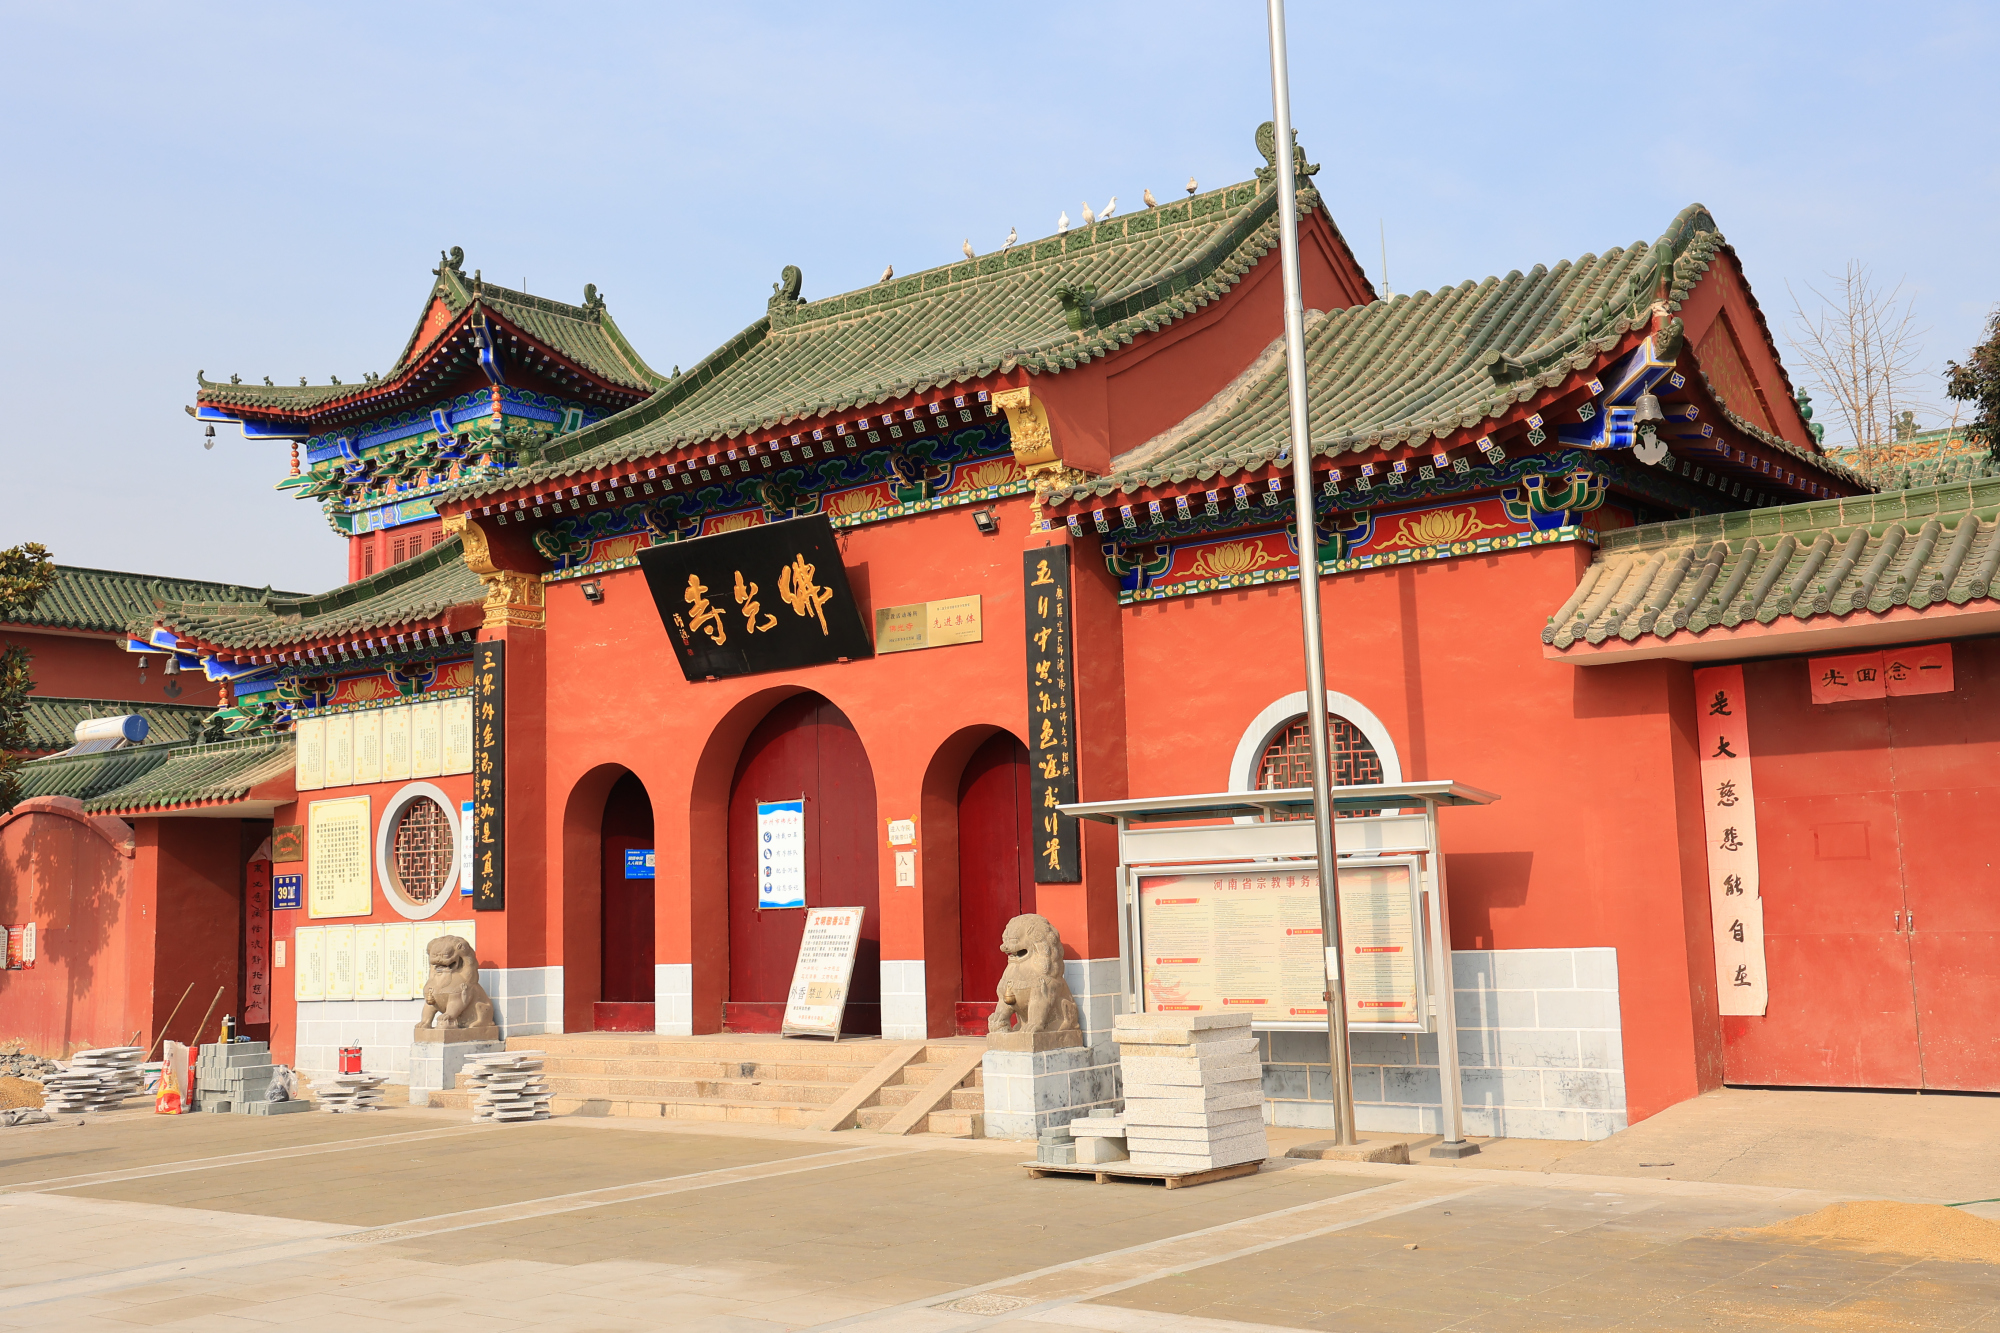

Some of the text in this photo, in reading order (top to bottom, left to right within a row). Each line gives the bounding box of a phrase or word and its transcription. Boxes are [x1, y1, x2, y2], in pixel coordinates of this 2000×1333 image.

[684, 553, 834, 646] 佛光寺
[889, 623, 914, 632] 佛光寺
[933, 614, 976, 629] 先进集体
[1709, 690, 1752, 988] 是大慈悲能自在
[898, 855, 908, 882] 入口
